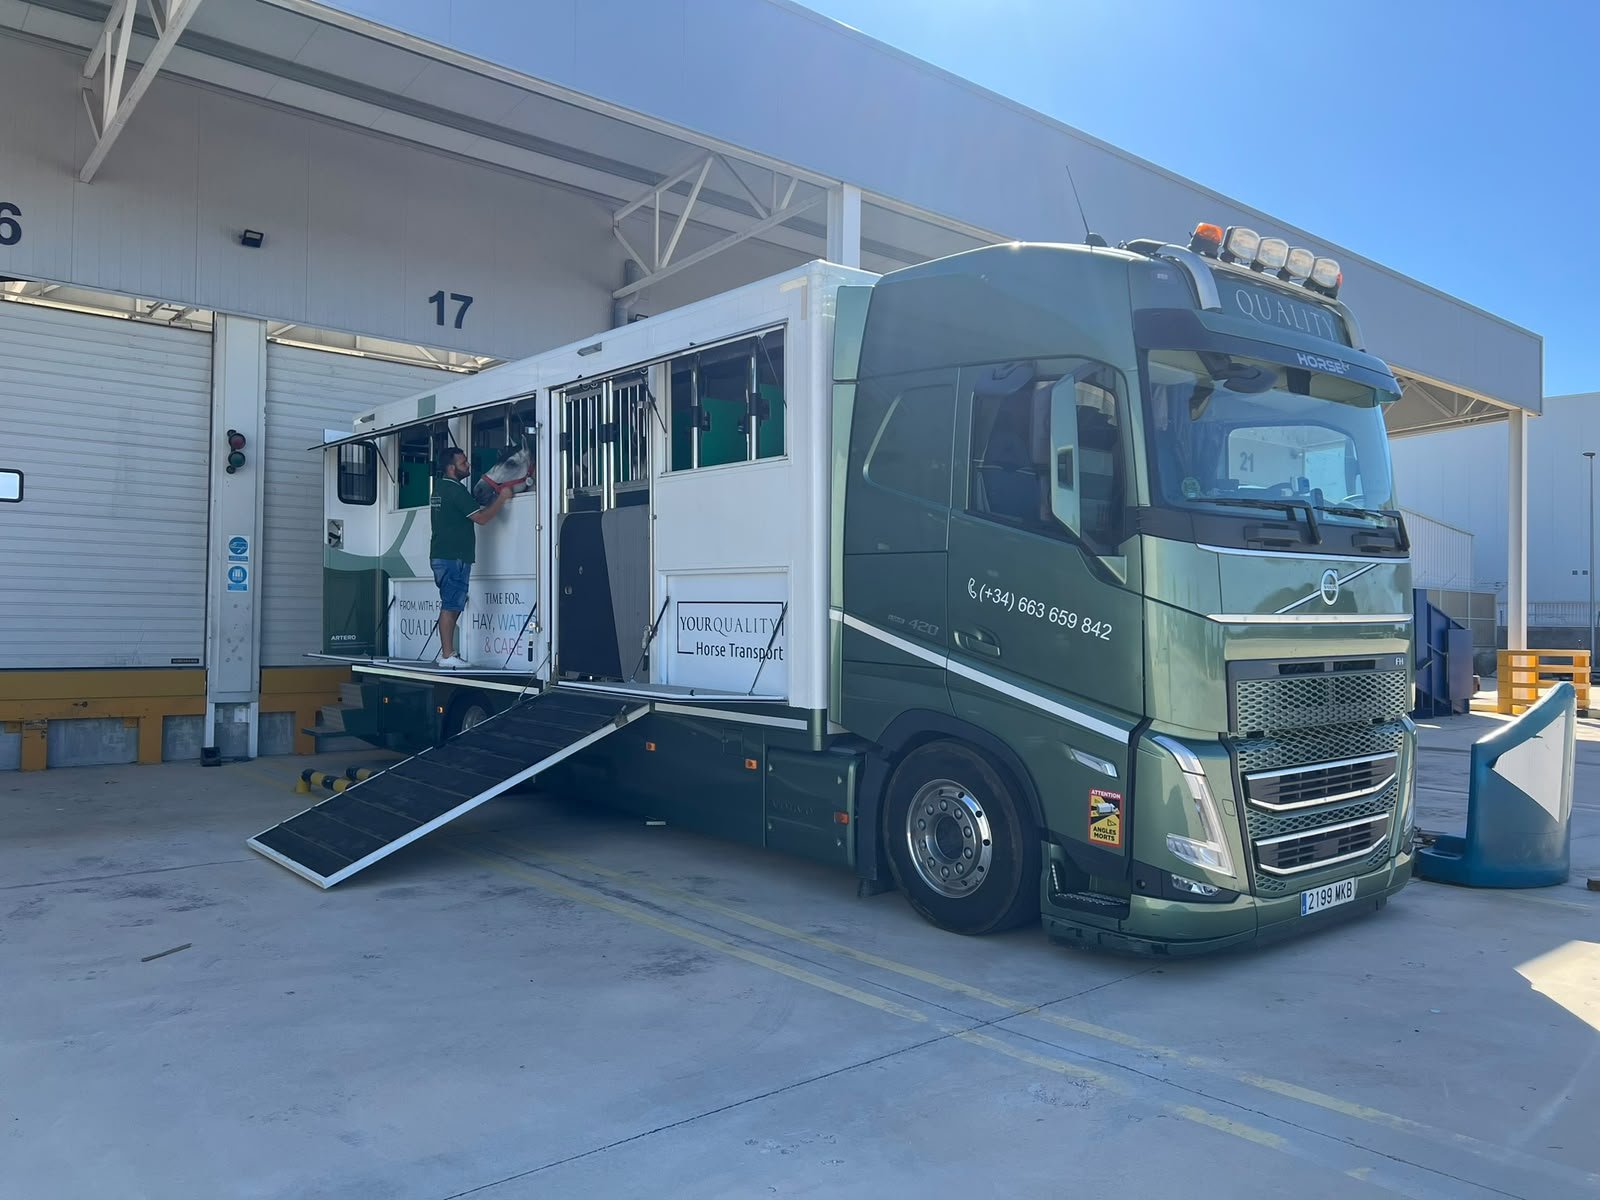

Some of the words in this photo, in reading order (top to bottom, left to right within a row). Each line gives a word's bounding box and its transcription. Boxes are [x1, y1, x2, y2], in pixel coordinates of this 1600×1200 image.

[428, 290, 473, 329] 17
[1235, 289, 1335, 340] QUALITY
[1240, 451, 1254, 472] 21
[485, 592, 502, 604] TIME
[979, 584, 1015, 612] (+34)
[1018, 597, 1045, 618] 663
[1048, 607, 1078, 629] 659
[1081, 617, 1112, 641] 842
[472, 613, 495, 632] HAY,
[909, 619, 939, 636] 420
[485, 638, 491, 654] &
[493, 637, 523, 656] CARE
[696, 641, 726, 657] Horse
[729, 643, 784, 662] Transport
[1091, 789, 1121, 799] ATTENTION
[1093, 826, 1117, 836] ANGLES
[1093, 832, 1115, 842] MORTS
[1308, 887, 1333, 910] 2199
[1335, 881, 1352, 901] MKB
